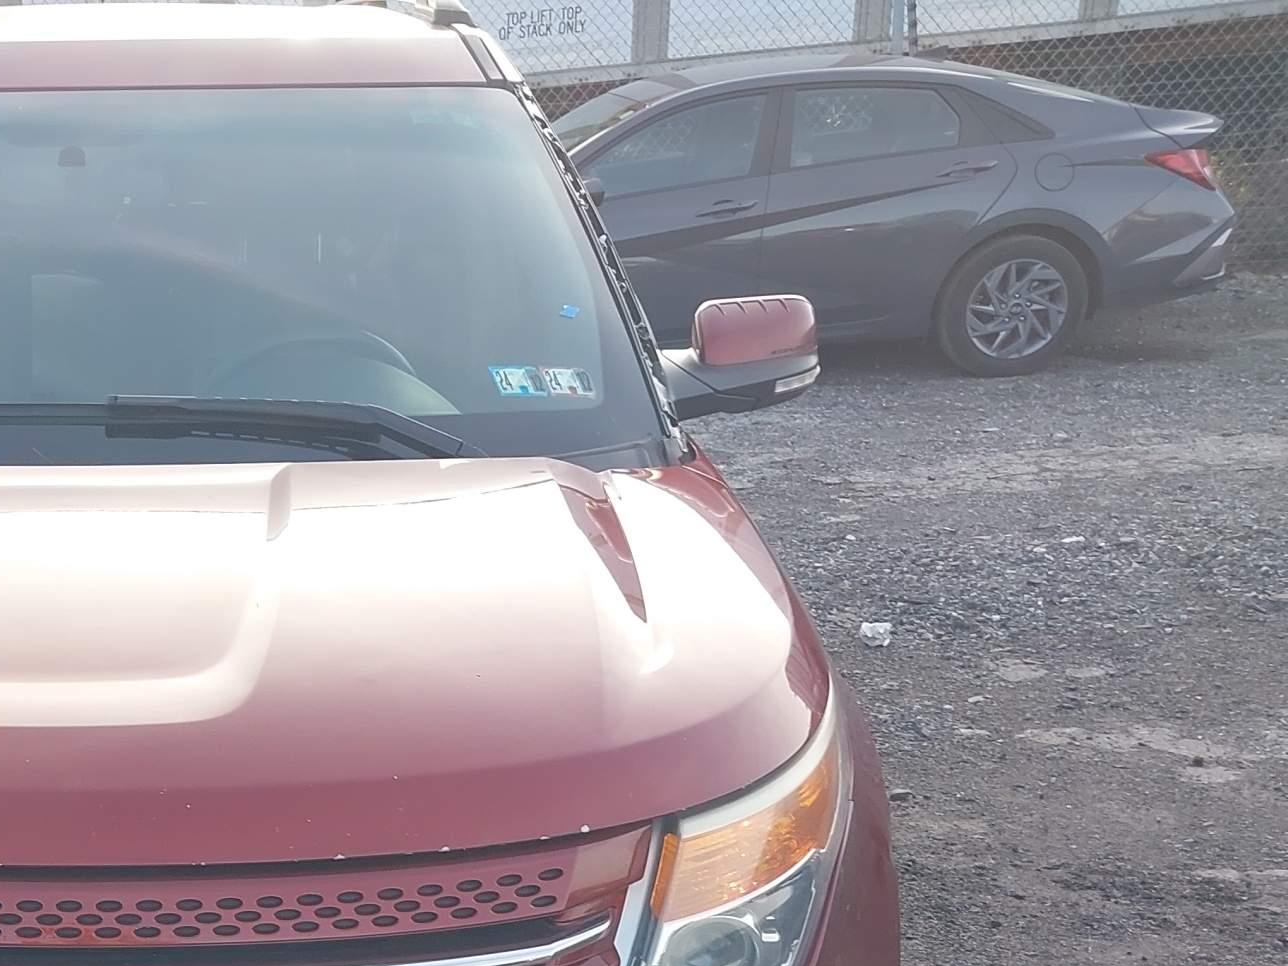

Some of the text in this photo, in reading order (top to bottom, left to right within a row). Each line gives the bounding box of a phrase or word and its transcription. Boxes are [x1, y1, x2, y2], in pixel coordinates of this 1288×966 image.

[506, 6, 582, 26] TOP LIFT TOP
[498, 20, 586, 40] OF STACK ONLY
[495, 370, 514, 391] 24
[544, 370, 563, 391] 24
